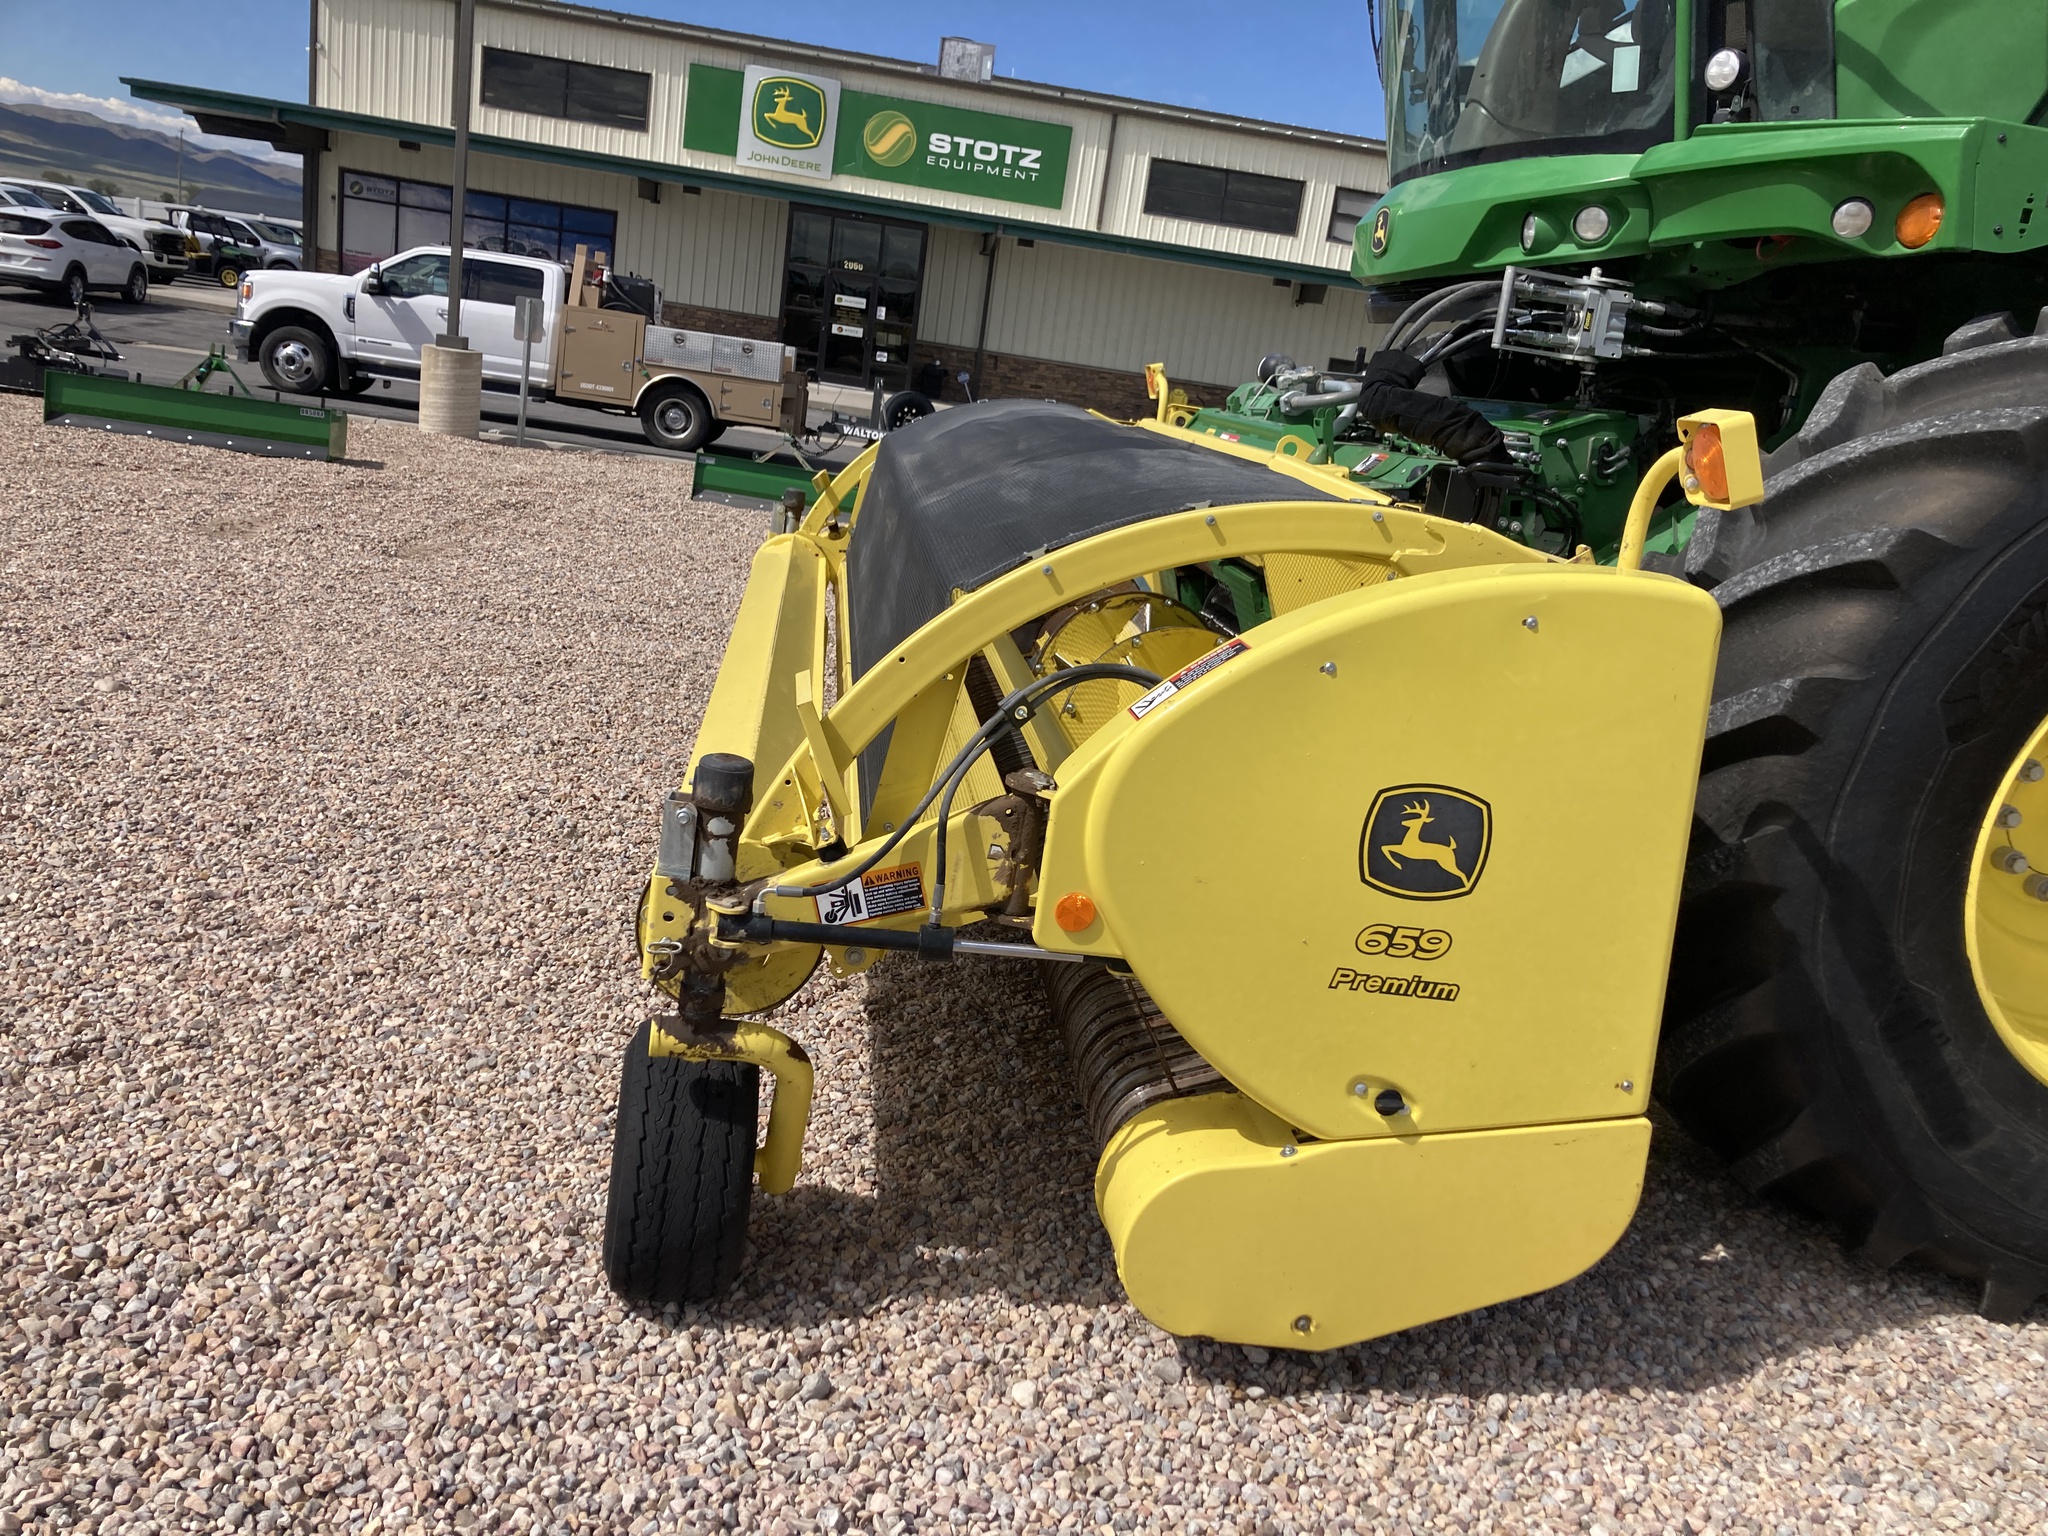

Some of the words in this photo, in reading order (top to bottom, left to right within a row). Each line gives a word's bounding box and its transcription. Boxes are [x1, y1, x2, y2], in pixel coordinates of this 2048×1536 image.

[747, 150, 779, 165] JOHN
[781, 156, 822, 172] DEERE
[928, 132, 1042, 170] STOTZ
[926, 154, 1039, 182] EQUIPMENT
[843, 259, 864, 271] 2060
[874, 866, 919, 883] WARNING
[1355, 923, 1453, 961] 659
[1328, 967, 1461, 1002] Premium
